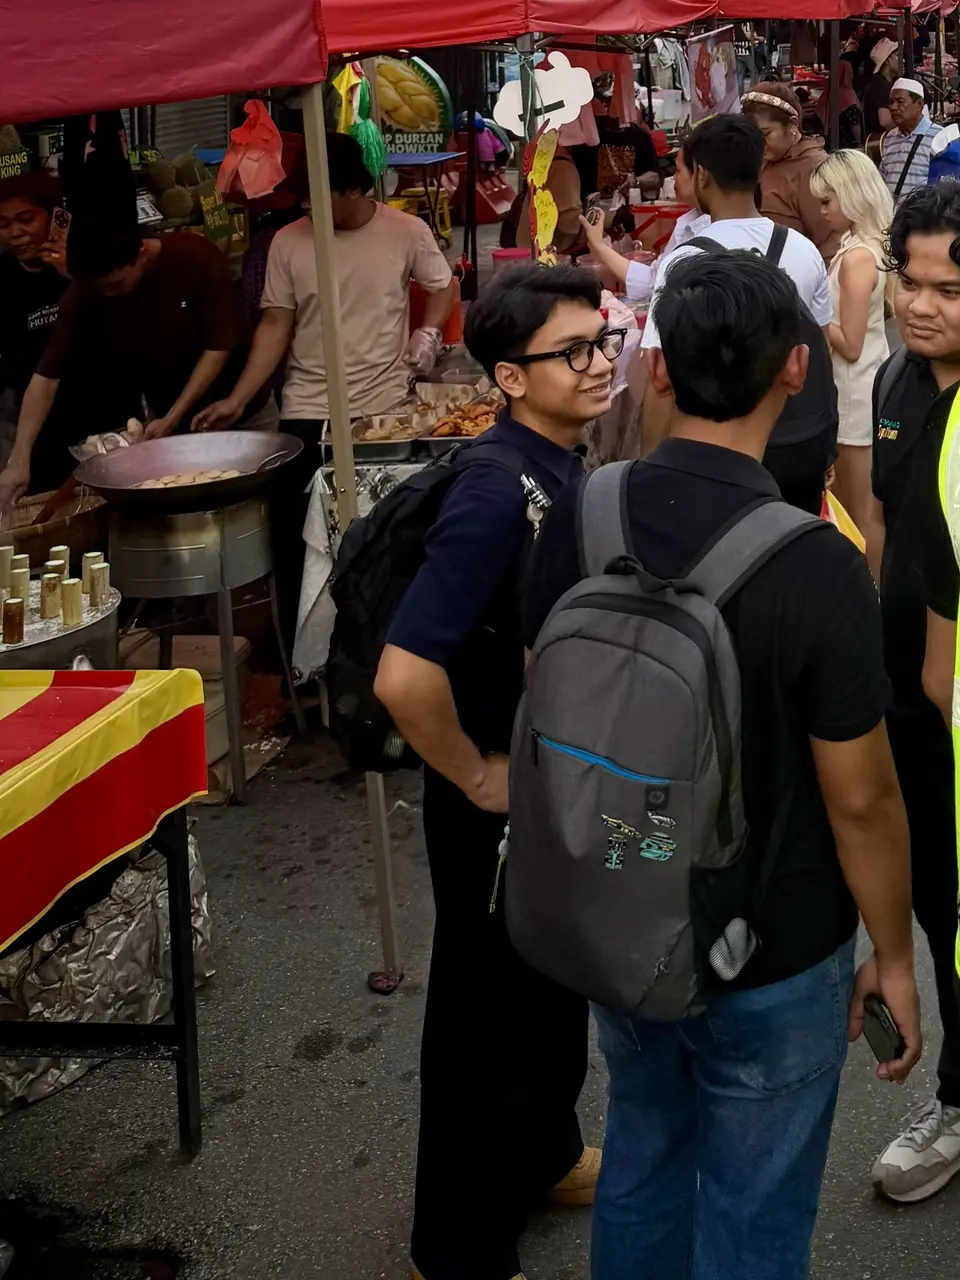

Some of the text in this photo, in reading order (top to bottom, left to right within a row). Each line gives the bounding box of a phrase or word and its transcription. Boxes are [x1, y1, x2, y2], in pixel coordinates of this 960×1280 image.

[395, 133, 444, 144] DURIAN
[384, 143, 440, 154] HOWKIT
[0, 164, 21, 179] KING
